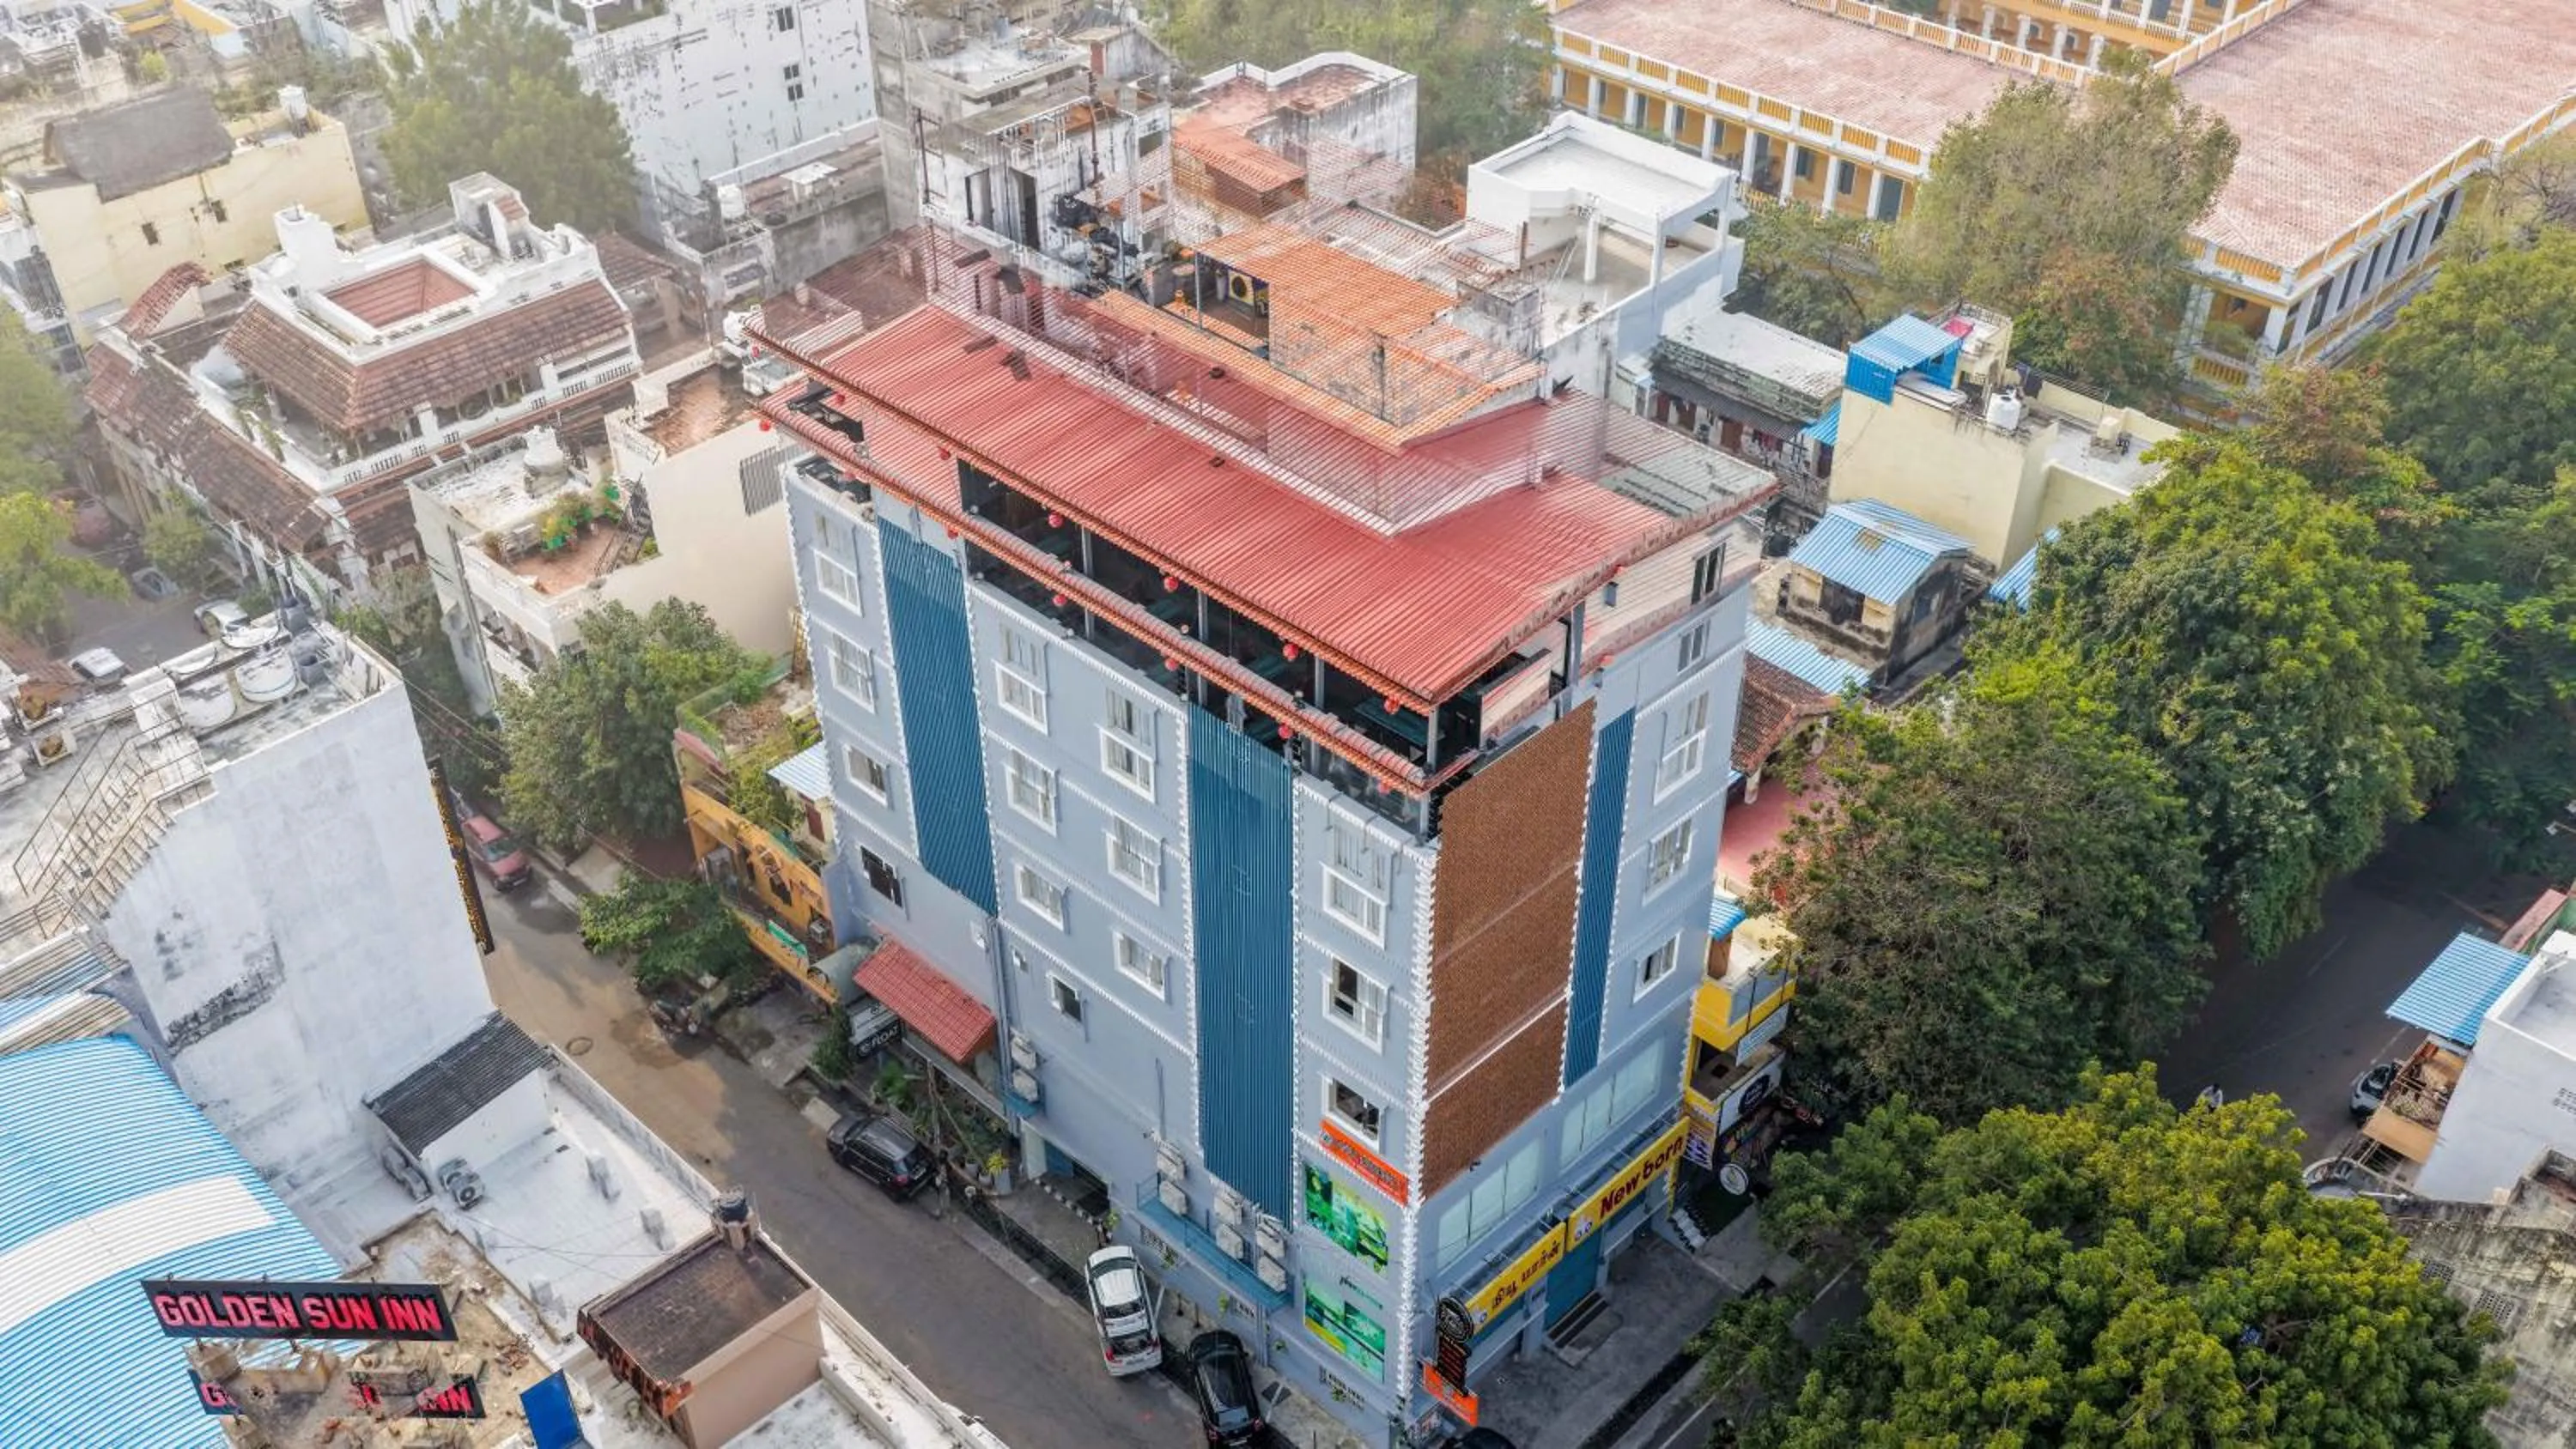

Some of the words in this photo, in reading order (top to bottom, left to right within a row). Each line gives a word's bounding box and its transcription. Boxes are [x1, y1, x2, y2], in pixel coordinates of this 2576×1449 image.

[1600, 1172, 1641, 1219] New
[1642, 1137, 1684, 1180] born
[154, 1293, 301, 1329] GOLDEN
[301, 1294, 380, 1331] SUN
[379, 1295, 443, 1332] INN
